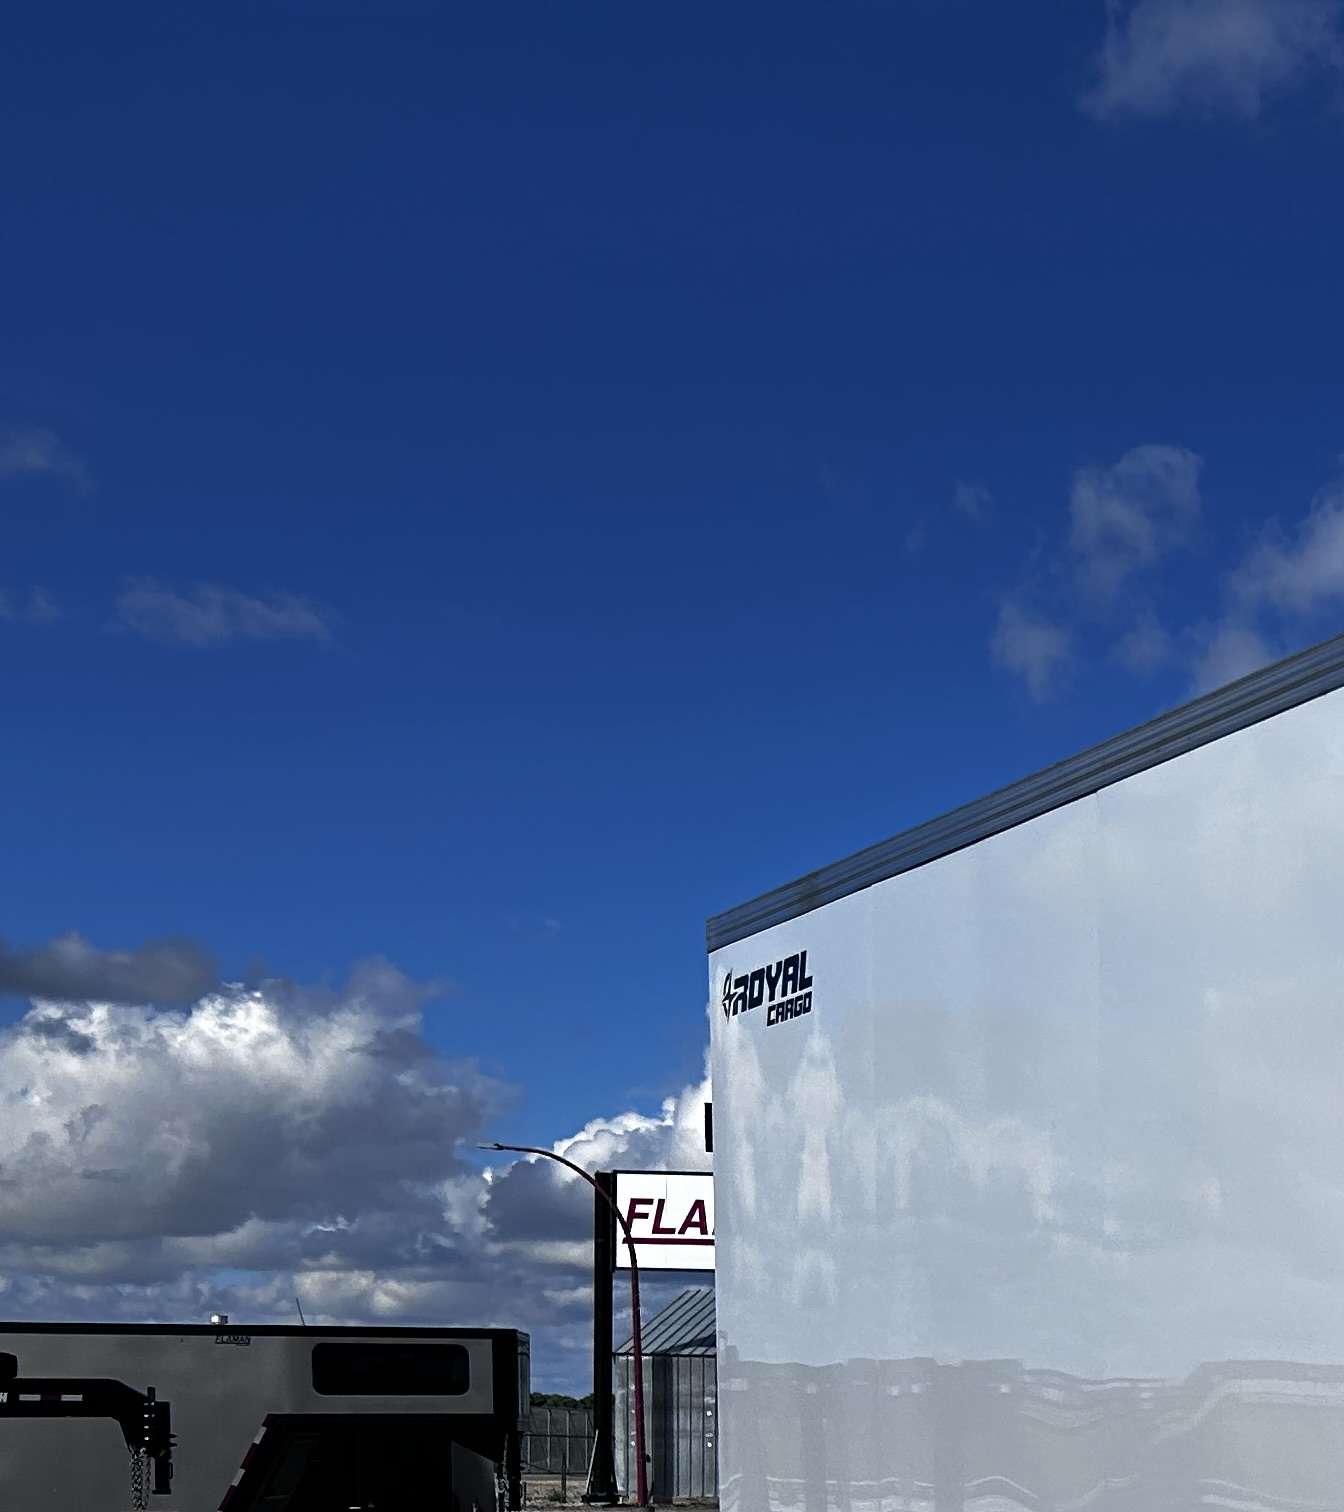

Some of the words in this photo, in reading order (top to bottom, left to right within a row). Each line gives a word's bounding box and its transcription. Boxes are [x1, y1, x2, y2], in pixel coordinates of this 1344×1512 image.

[732, 949, 813, 1016] ROYAL
[766, 991, 813, 1027] CARGO
[625, 1198, 714, 1235] FLA
